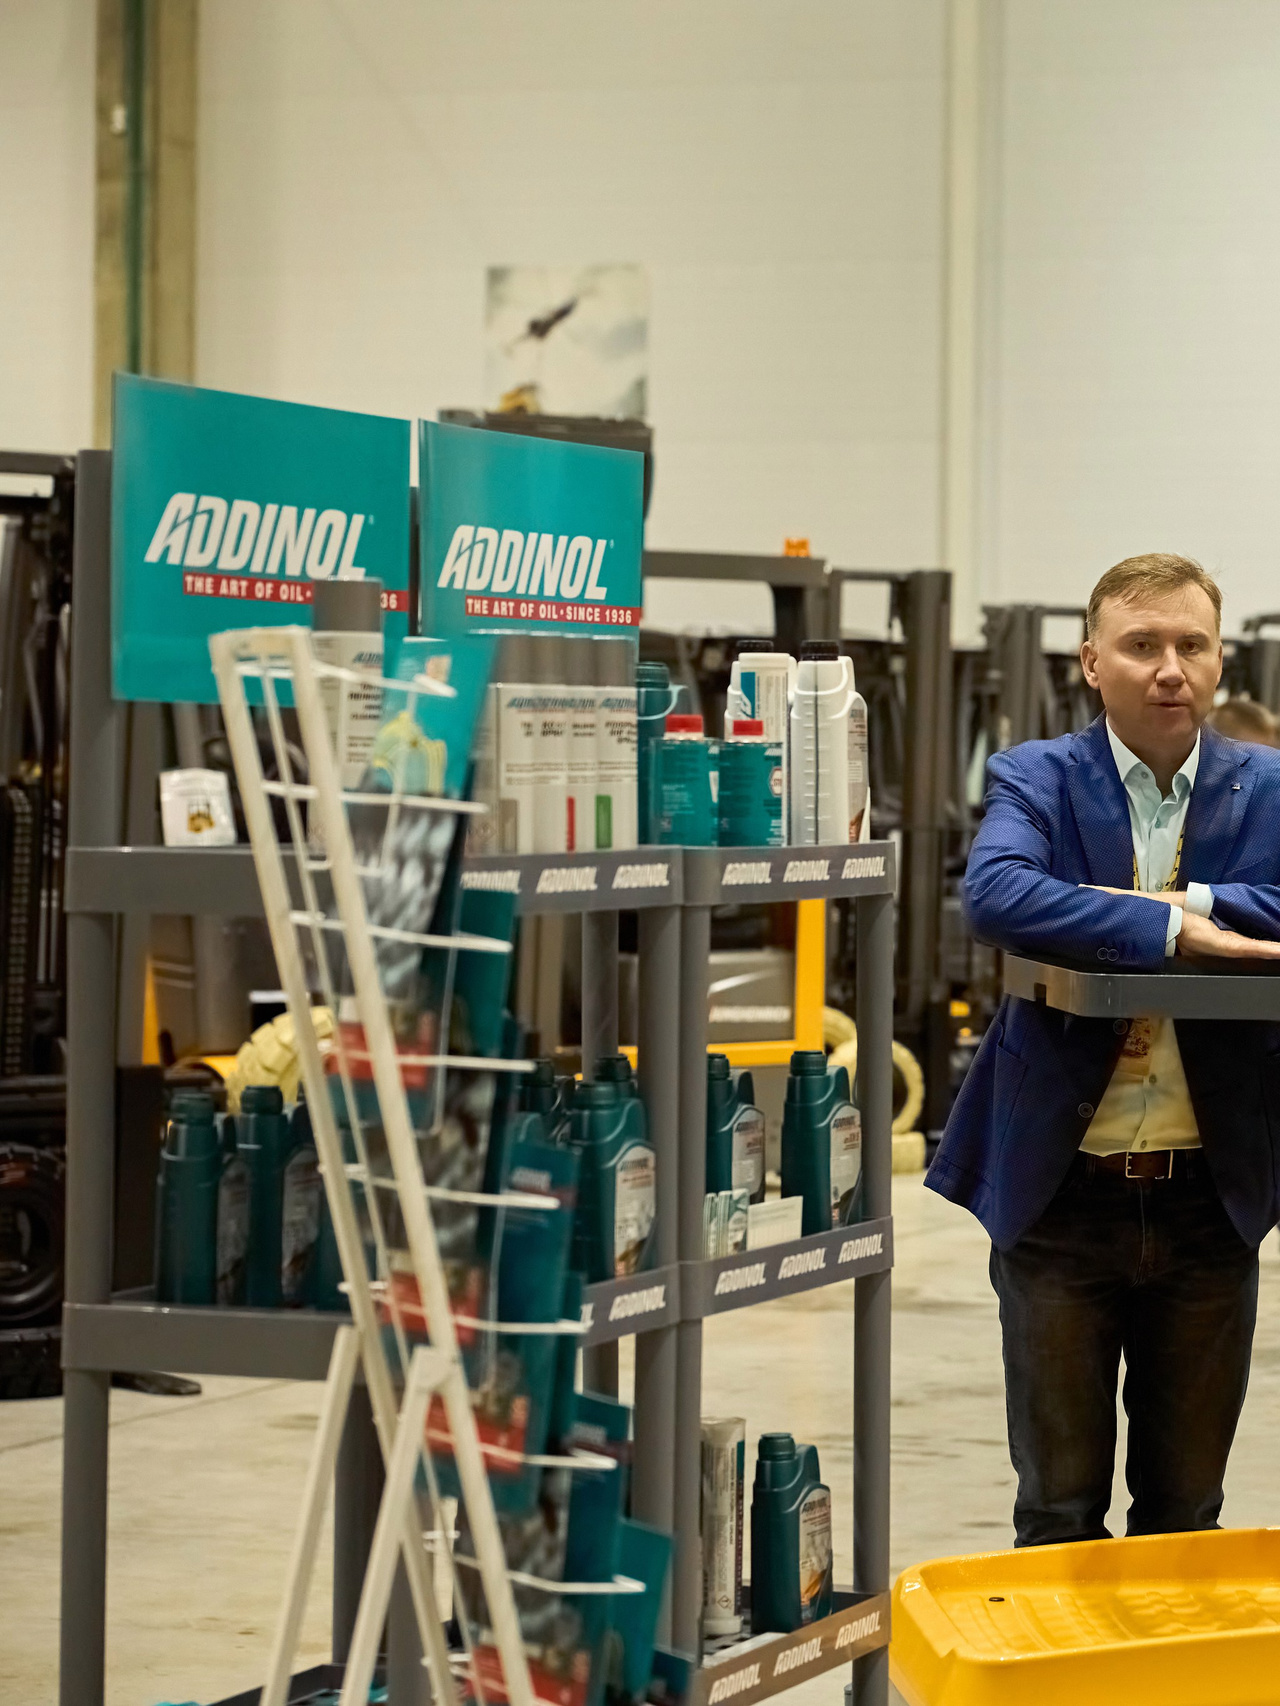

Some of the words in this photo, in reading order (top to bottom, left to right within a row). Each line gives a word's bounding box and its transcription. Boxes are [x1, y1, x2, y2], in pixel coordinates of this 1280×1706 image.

[144, 492, 366, 581] ADDINOL
[437, 524, 607, 600] ADDINOL
[185, 575, 214, 595] THE
[219, 578, 249, 598] ART
[254, 581, 274, 600] OF
[467, 598, 488, 615] THE
[493, 600, 515, 616] ART
[520, 602, 535, 618] OF
[605, 608, 632, 624] 1936
[721, 861, 772, 886] ADDINOL
[782, 859, 831, 883] ADDINOL
[841, 855, 887, 880] ADDINOL
[714, 1261, 767, 1296] ADDINOL
[778, 1247, 827, 1280] ADDINOL
[838, 1233, 884, 1264] ADDINOL
[608, 1284, 667, 1322] ADDINOL
[707, 1661, 762, 1706] ADDINOL
[773, 1636, 823, 1677] ADDINOL
[835, 1610, 881, 1650] ADDINOL
